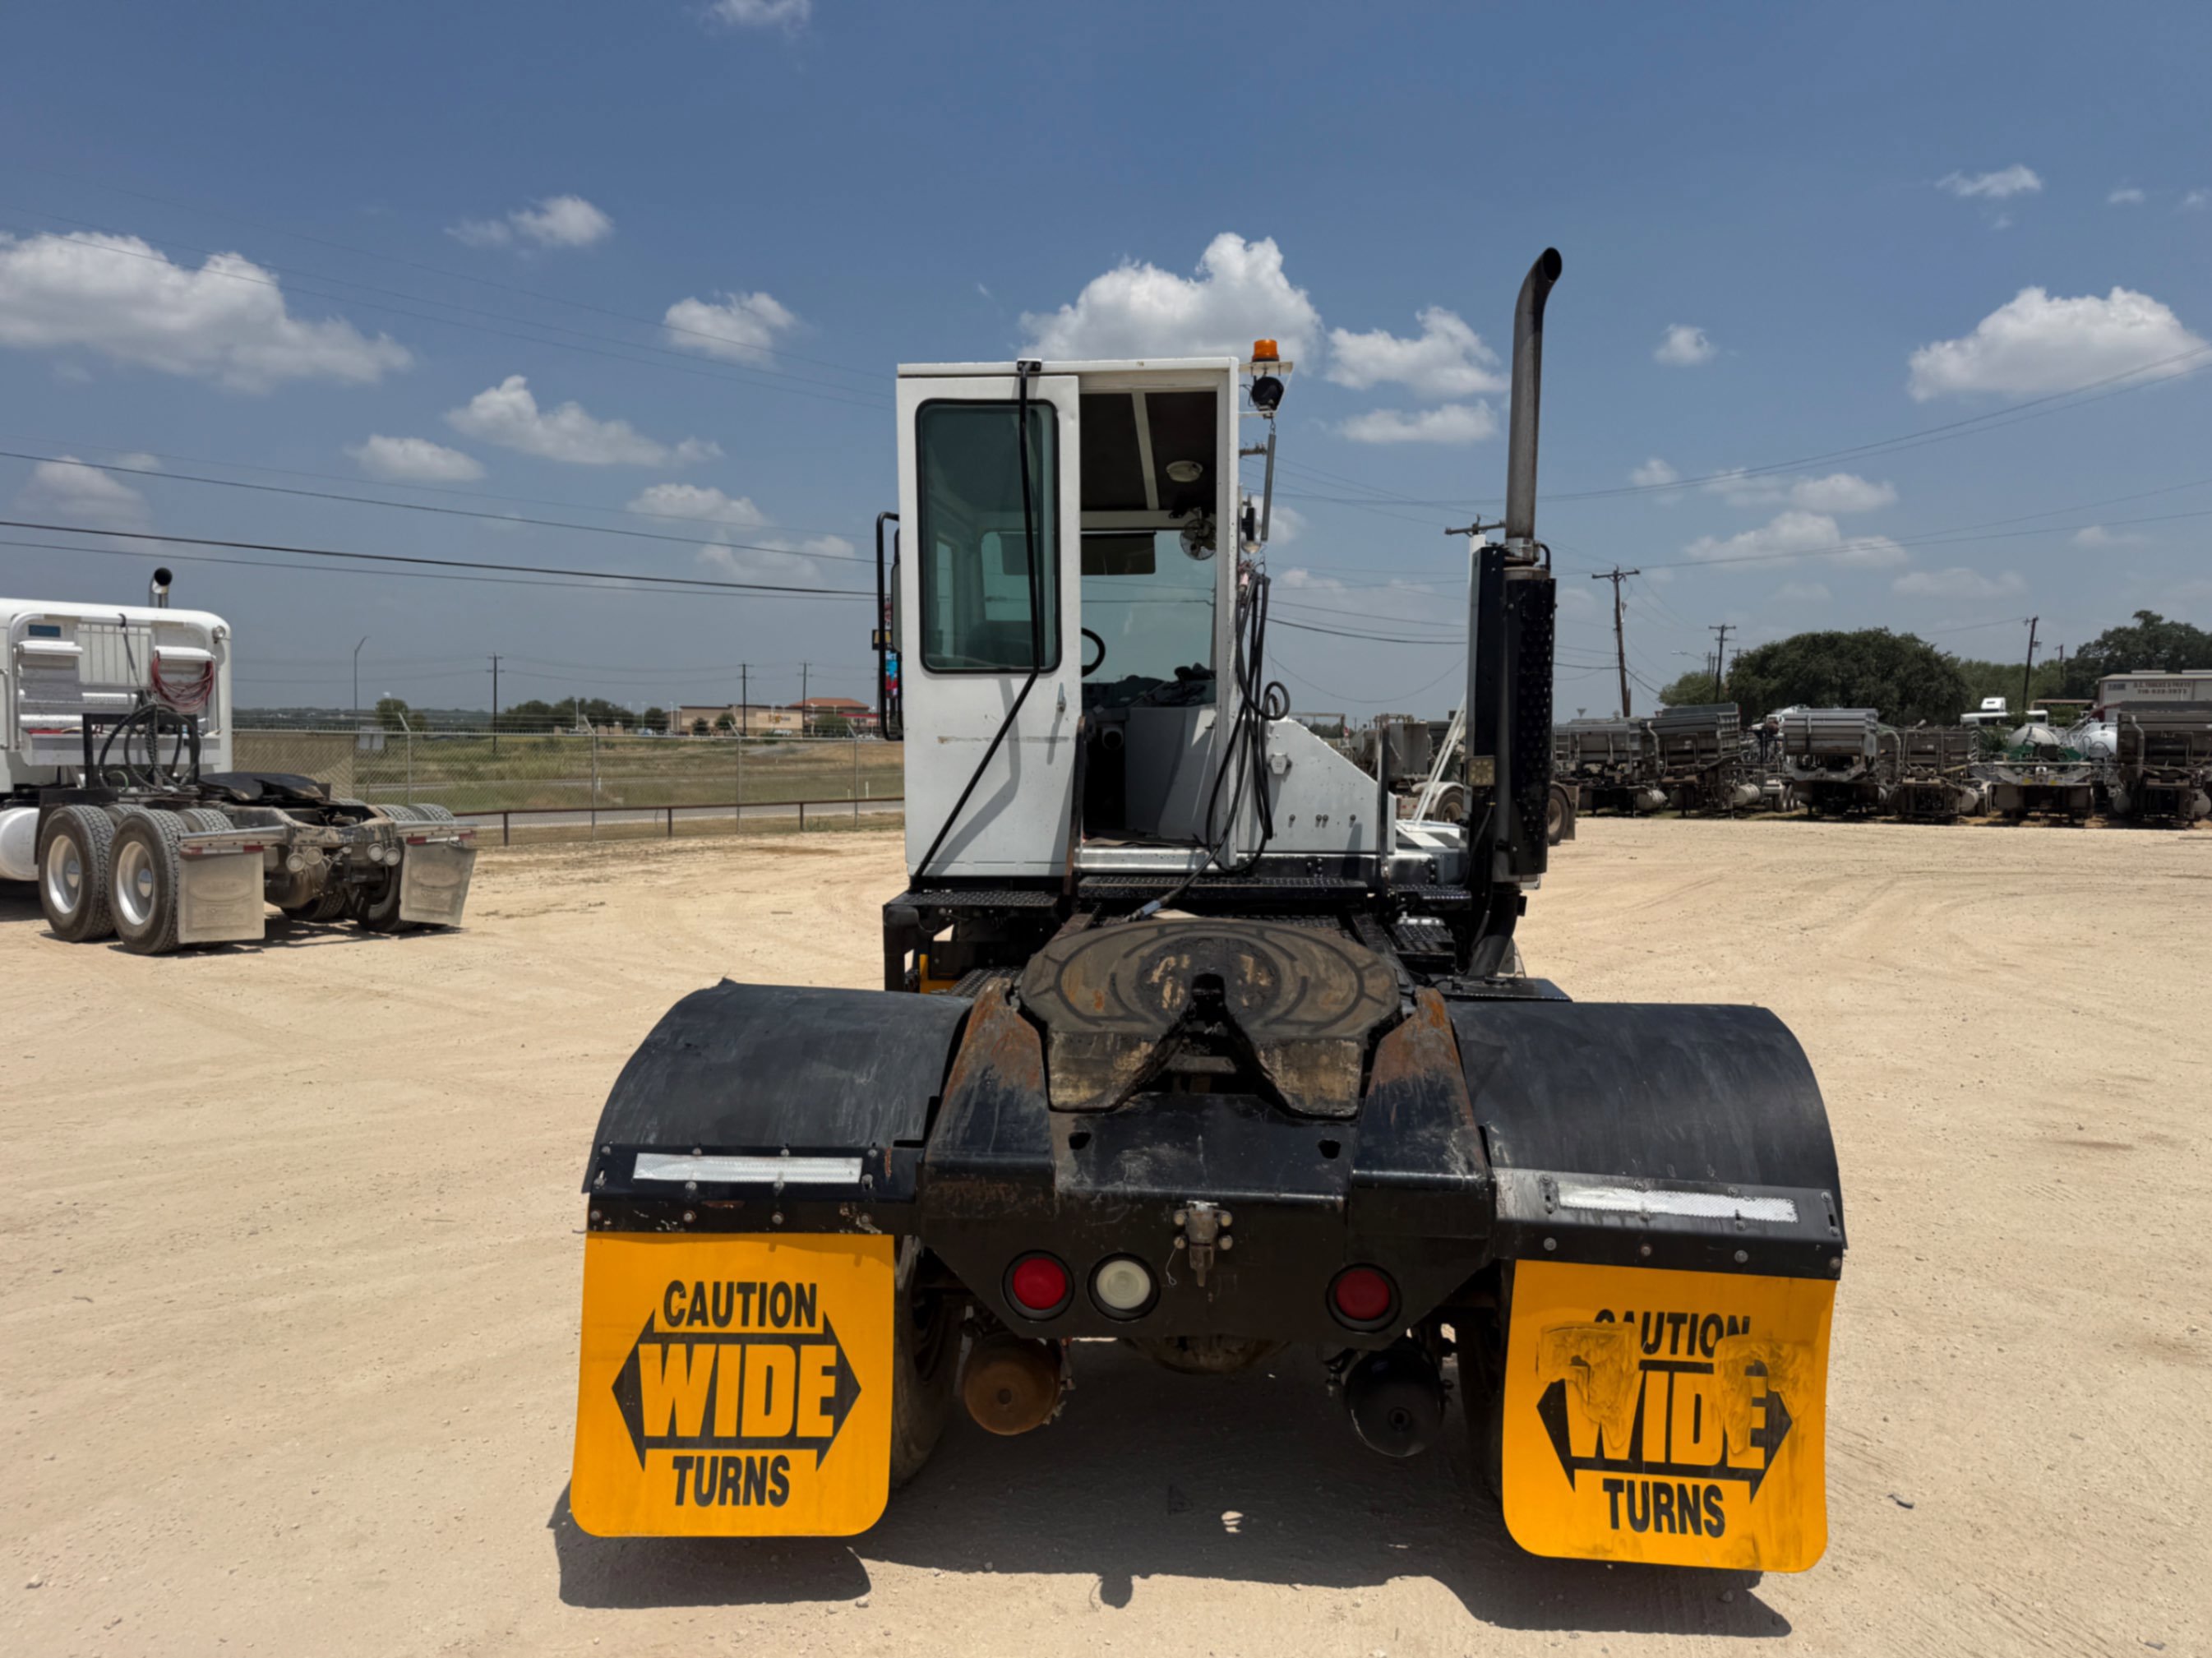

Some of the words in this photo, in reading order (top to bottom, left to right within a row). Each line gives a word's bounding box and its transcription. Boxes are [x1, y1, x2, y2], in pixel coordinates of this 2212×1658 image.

[663, 1280, 818, 1328] CAUTION
[1593, 1309, 1752, 1359] UTIO
[638, 1343, 838, 1438] WIDE
[1563, 1368, 1767, 1470] WIDE
[672, 1455, 791, 1508] TURNS
[1602, 1477, 1725, 1539] TURNS
